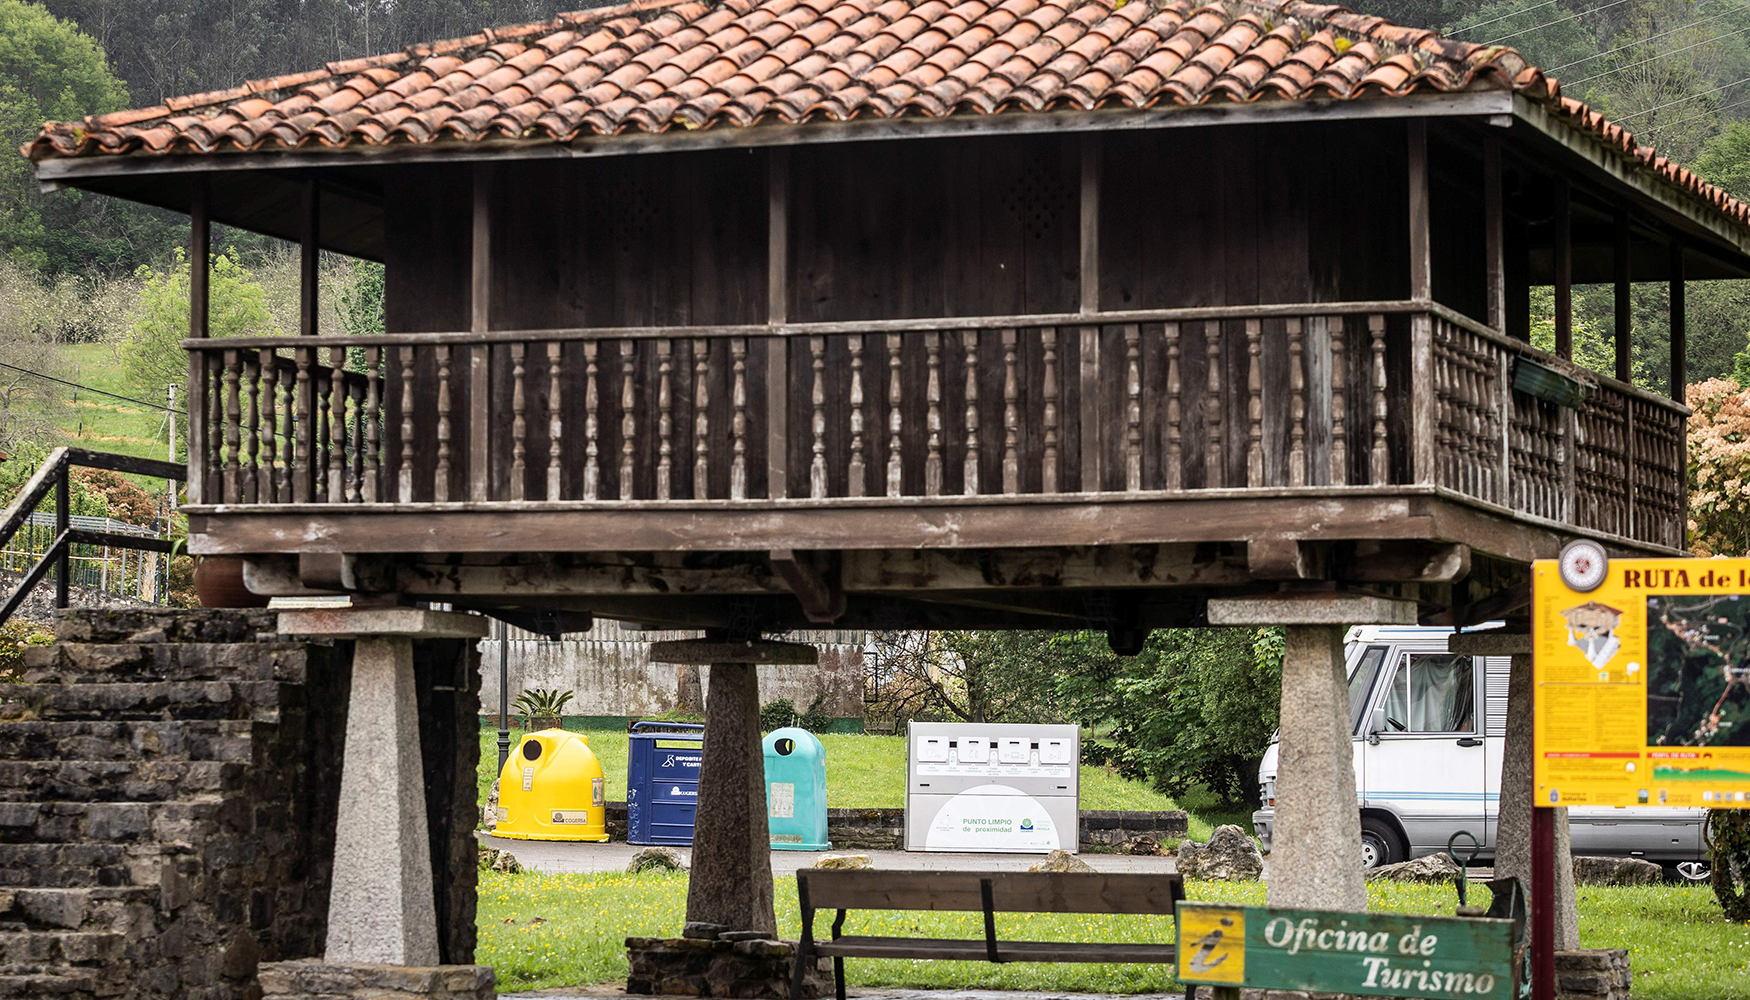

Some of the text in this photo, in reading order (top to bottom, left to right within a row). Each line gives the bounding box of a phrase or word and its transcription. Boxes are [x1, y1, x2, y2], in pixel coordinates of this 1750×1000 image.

[1624, 569, 1690, 588] RUTA
[1699, 569, 1731, 587] de
[1264, 916, 1438, 957] Oficina de
[1361, 956, 1495, 994] Turismo
